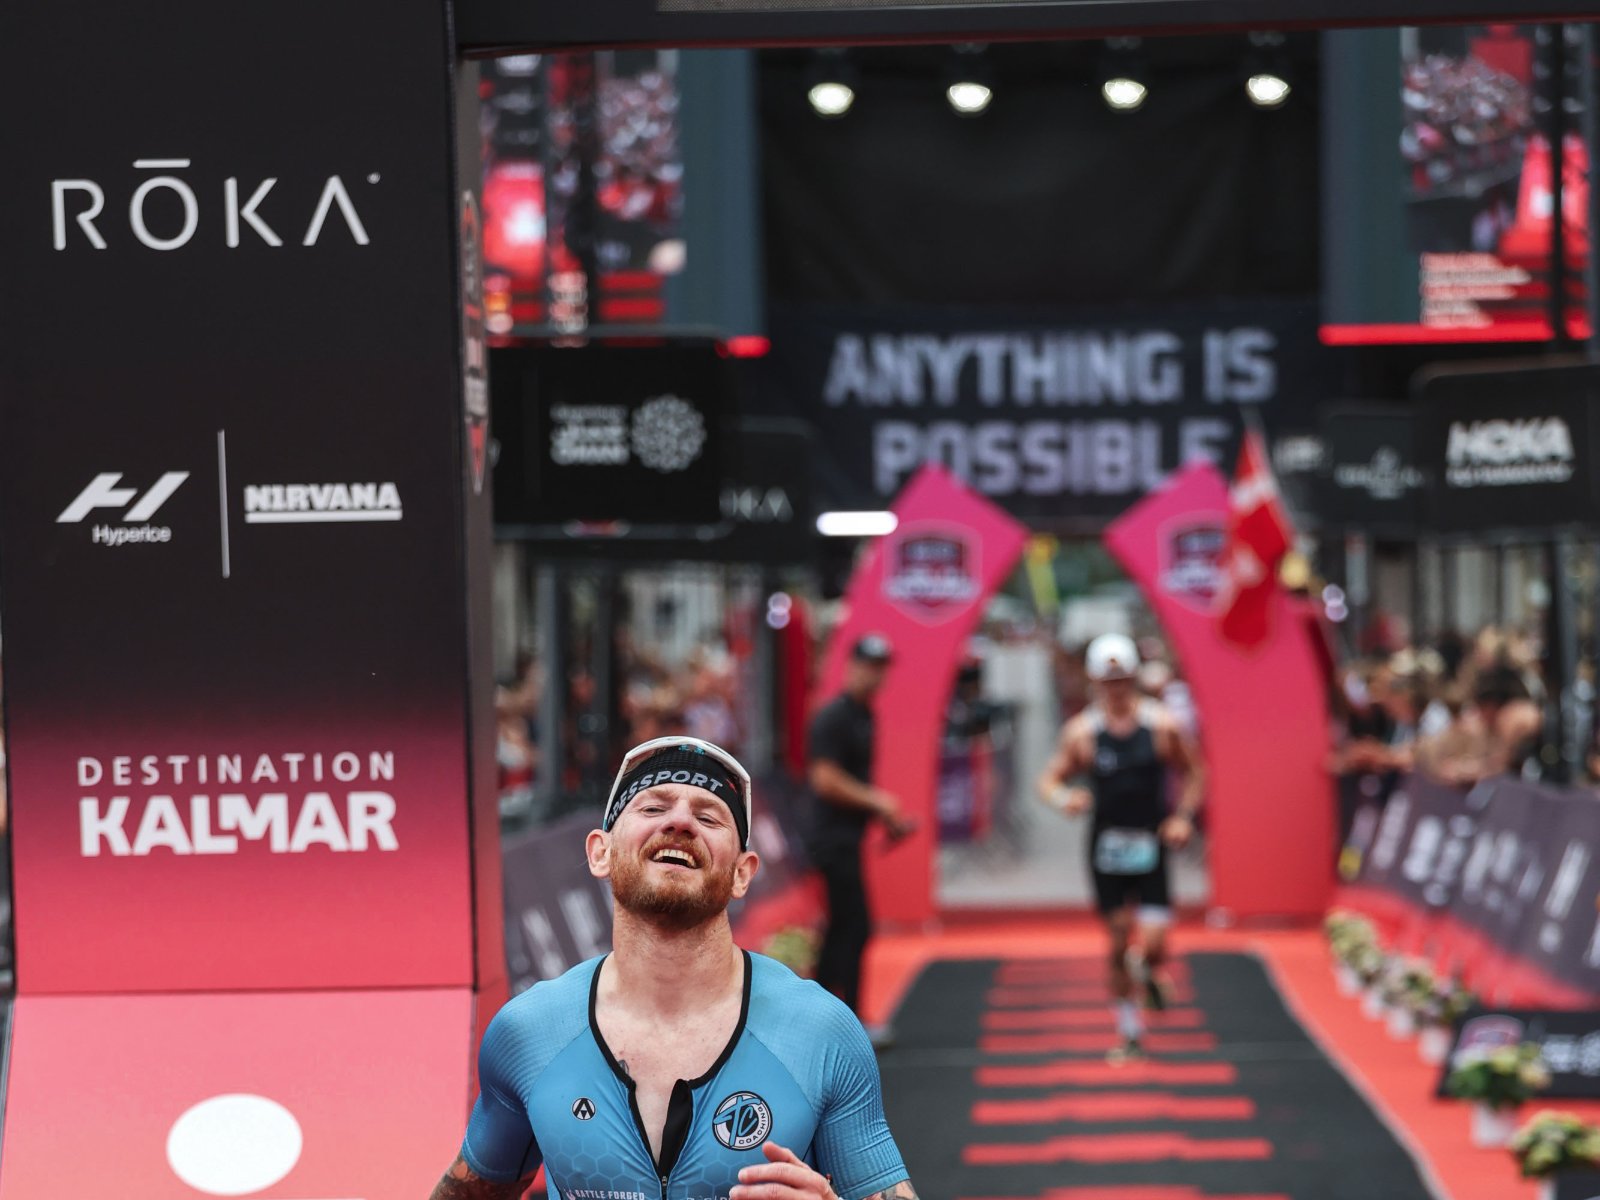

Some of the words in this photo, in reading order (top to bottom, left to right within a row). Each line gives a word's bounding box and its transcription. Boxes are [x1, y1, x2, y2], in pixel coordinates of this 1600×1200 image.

[822, 330, 1184, 406] ANYTHING
[1203, 326, 1278, 404] IS
[243, 482, 403, 512] NIRVANA
[91, 523, 172, 548] Hyperice
[77, 750, 396, 787] DESTINATION
[79, 790, 400, 858] KALMAR
[738, 1106, 767, 1145] COACHING
[575, 1189, 606, 1200] BATTLE
